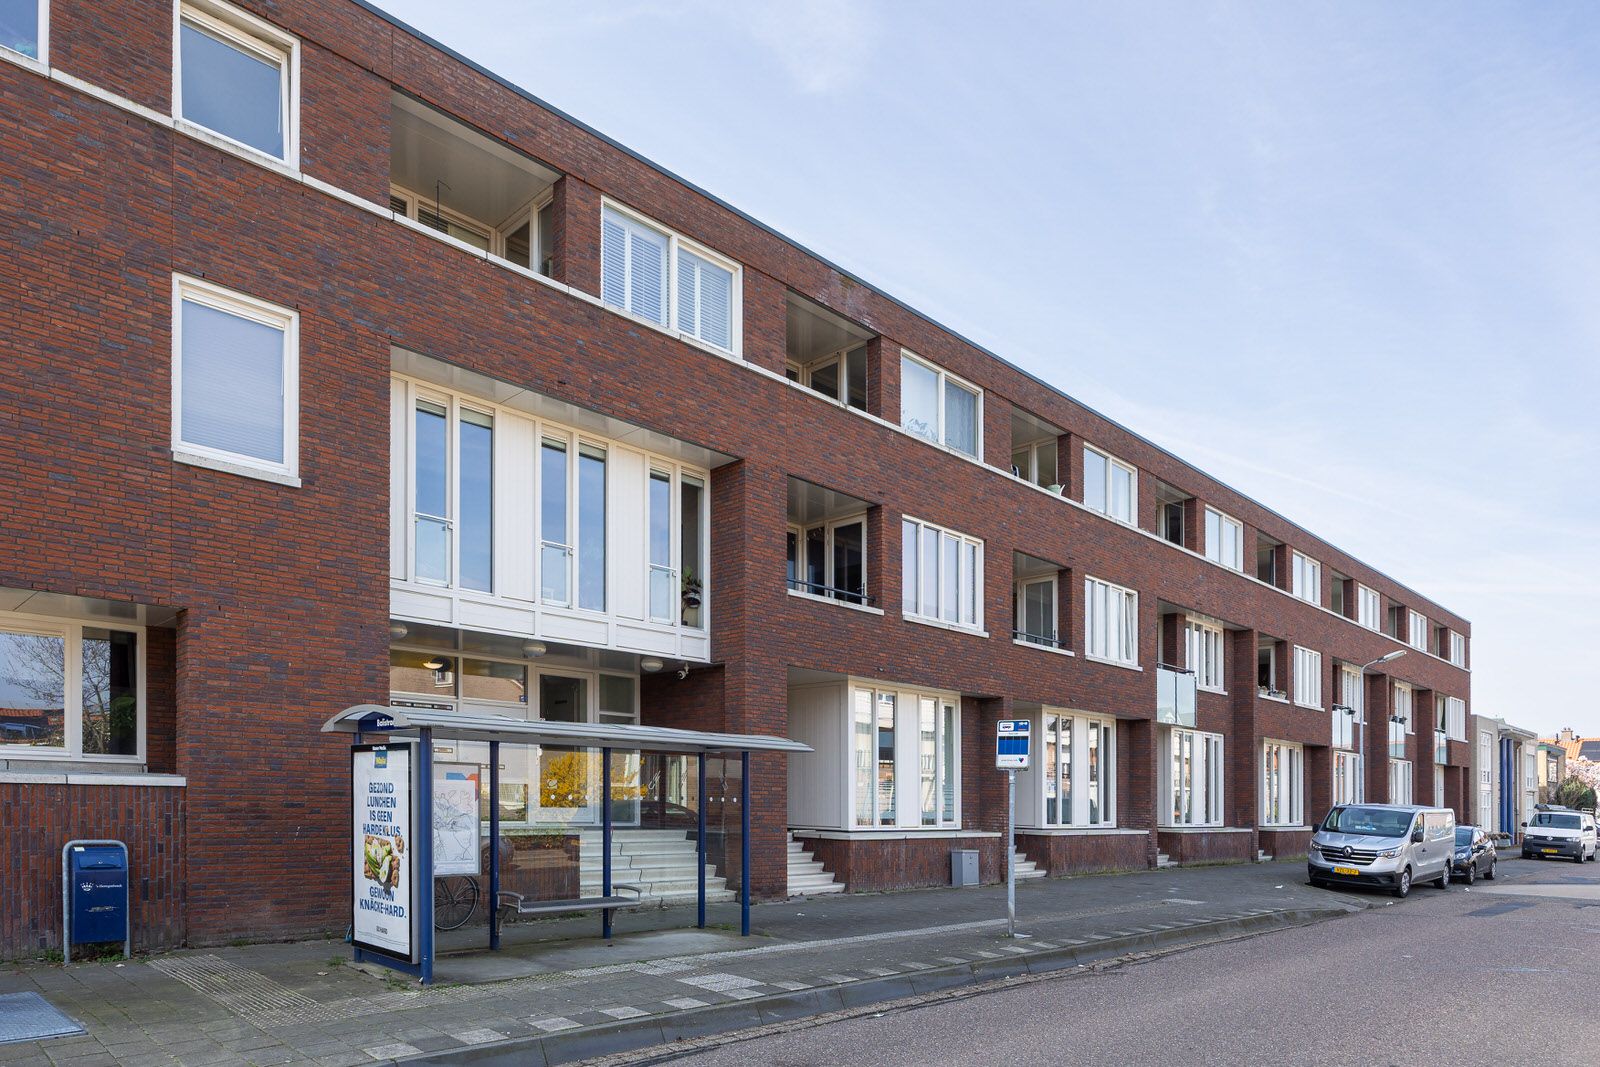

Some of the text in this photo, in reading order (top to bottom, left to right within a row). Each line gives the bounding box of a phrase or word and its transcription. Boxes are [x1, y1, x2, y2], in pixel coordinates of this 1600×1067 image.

[368, 782, 394, 794] GEZOND
[367, 796, 397, 808] LUNCHEN
[369, 810, 393, 822] IS GEEN
[363, 823, 382, 836] HARDE
